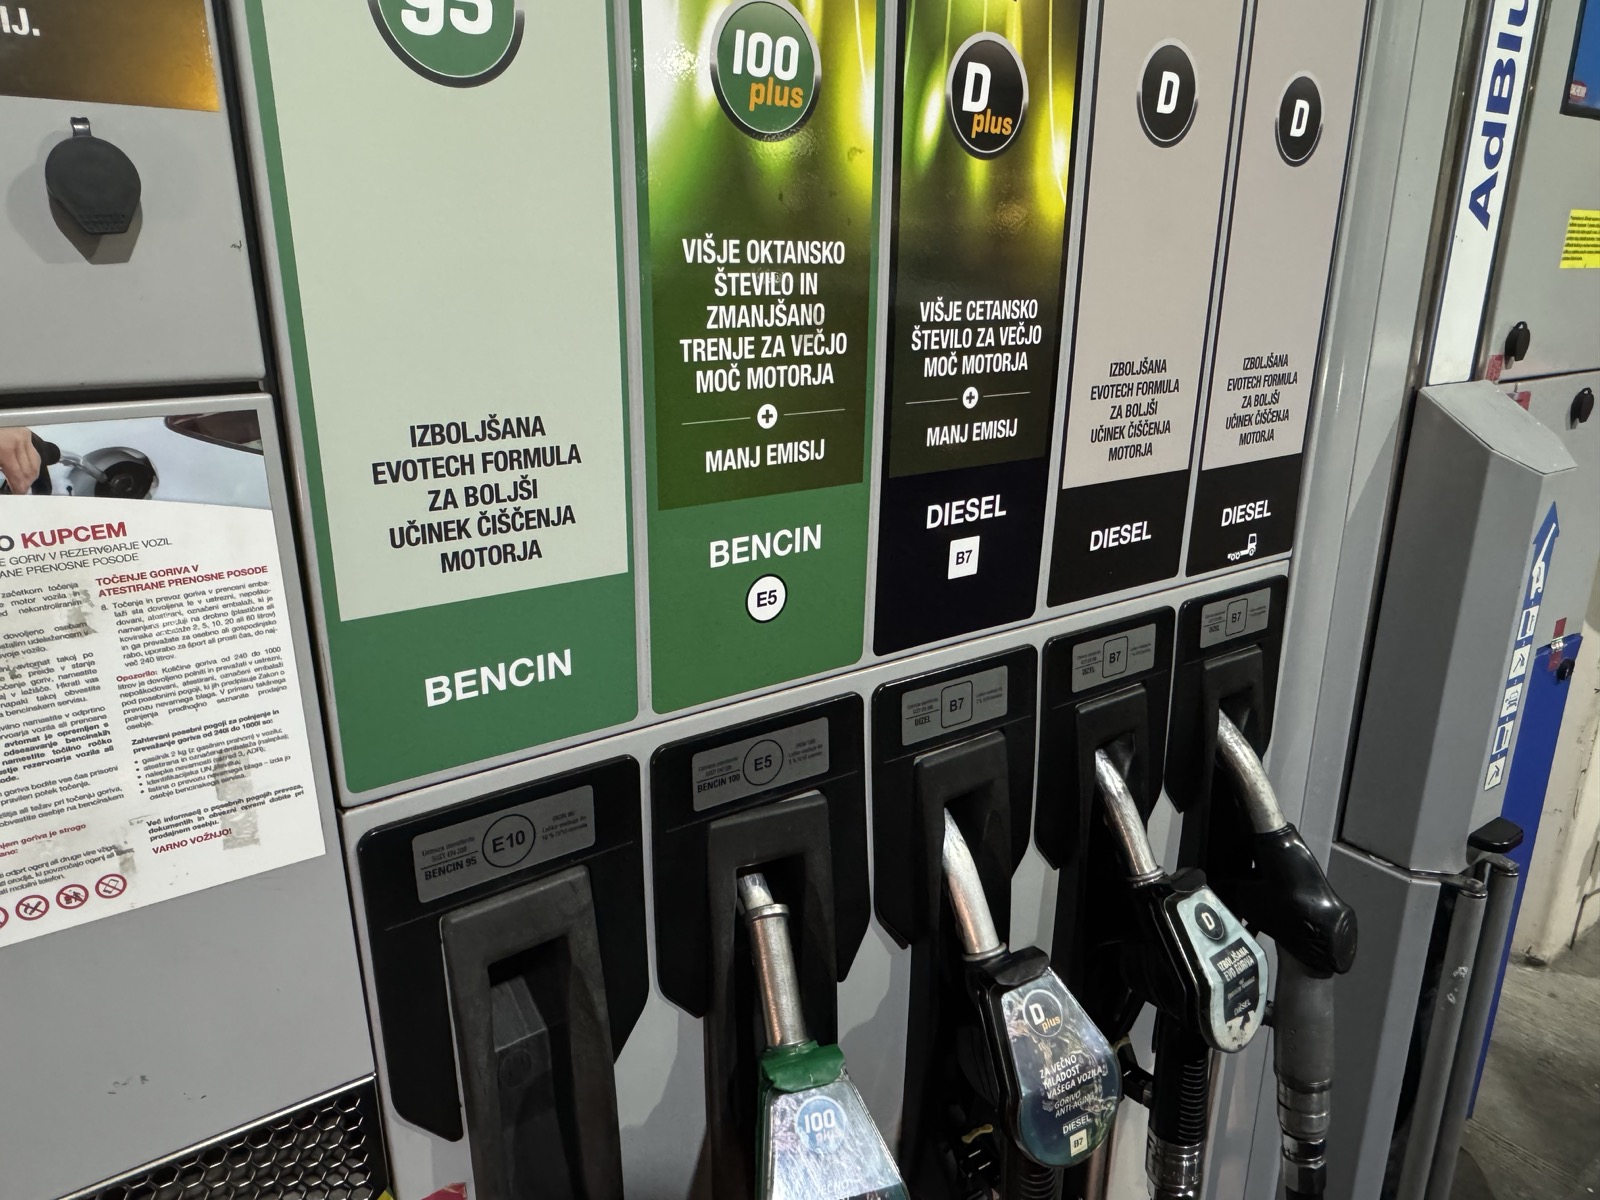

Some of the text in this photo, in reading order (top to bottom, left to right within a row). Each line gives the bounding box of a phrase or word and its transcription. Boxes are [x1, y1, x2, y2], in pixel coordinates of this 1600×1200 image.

[401, 0, 492, 35] 95
[733, 29, 800, 77] 100
[749, 77, 804, 112] plus
[962, 61, 991, 113] D
[1156, 70, 1180, 115] D
[971, 108, 1013, 138] plus
[1289, 98, 1310, 137] D
[682, 233, 846, 265] VIŠJE OKTANSKO
[714, 267, 818, 297] ŠTEVILO IN
[706, 299, 825, 329] ZMANJŠANO
[920, 296, 1038, 322] VIŠJE CETANSKO
[680, 328, 848, 362] TRENJE ZA VEČJO
[911, 321, 1042, 351] ŠTEVILO ZA VEČJO
[924, 351, 1028, 378] MOČ MOTORJA
[1109, 357, 1167, 377] IZBOLJŠANA
[1242, 352, 1289, 371] IZBOLJŠANA
[696, 362, 834, 393] MOČ MOTORJA
[1090, 378, 1180, 401] EVOTECH FORMULA
[1227, 371, 1298, 392] EVOTECH FORMULA
[1109, 398, 1158, 420] ZA BOLJŠI
[1241, 389, 1280, 408] ZA BOLJŠI
[409, 413, 547, 448] IZBOLJŠANA
[1090, 420, 1171, 443] UČINEK ČIŠČENJA
[1225, 408, 1290, 430] UČINEK ČIŠČENJA
[926, 418, 1018, 447] MANJ EMISIJ
[1238, 428, 1275, 447] MOTORJA
[371, 443, 582, 485] EVOTECH FORMULA
[705, 438, 825, 473] MANJ EMISIJ
[1108, 442, 1153, 462] MOTORJA
[427, 474, 538, 512] ZA BOLJŠI
[926, 494, 1007, 530] DIESEL
[1221, 499, 1272, 527] DIESEL
[21, 521, 128, 549] KUPCEM
[389, 504, 576, 549] UČINEK ČIŠČENJA
[1090, 521, 1152, 551] DIESEL
[9, 537, 173, 566] GORIV V REZERVOARJE VOZIL
[440, 539, 542, 574] MOTORJA
[709, 524, 822, 569] BENCIN
[955, 549, 973, 566] B7
[26, 559, 90, 576] PRENOSNE
[92, 552, 140, 567] POSODE
[95, 564, 199, 587] TOČENJE GORIVA V
[98, 565, 268, 598] ATESTIRANE PRENOSNE POSODE
[756, 589, 777, 608] E5
[1231, 611, 1242, 623] B7
[116, 670, 157, 682] Opozorilo:
[161, 664, 192, 674] Količine
[195, 659, 217, 669] goriva
[264, 646, 281, 654] 1000
[1109, 650, 1122, 664] B7
[424, 648, 573, 708] BENCIN
[949, 697, 965, 712] B7
[4, 724, 100, 748] avtomat je opremljen
[132, 732, 170, 745] Zahtevani
[171, 725, 202, 738] posebni
[204, 720, 227, 730] pogoji
[239, 711, 271, 723] polnjenje
[1, 738, 113, 766] namestite točilno ročko
[3, 729, 111, 757] odsesavanje bencinskih
[133, 740, 176, 754] prevažanje
[177, 734, 201, 745] goriva
[23, 745, 114, 770] rezervoarja vozila ali
[754, 754, 772, 772] E5
[697, 774, 741, 793] BENCIN 100
[148, 794, 292, 834] dokumentih obvezni opremi dobite
[163, 808, 202, 823] informacij
[211, 798, 244, 812] posebnih
[246, 791, 272, 804] pogojih
[274, 784, 303, 796] prevoza,
[20, 824, 87, 845] goriva je strogo
[150, 820, 219, 842] prodajnem osebju.
[152, 828, 232, 854] VARNO VOŽNJO!
[492, 830, 526, 853] E10
[424, 856, 478, 881] BENCIN 95
[1201, 912, 1216, 931] D
[1029, 1002, 1046, 1026] D
[1041, 1014, 1061, 1032] plus
[1039, 1054, 1077, 1079] ZA VEČNO
[1042, 1064, 1080, 1090] MLADOST
[1047, 1065, 1103, 1099] VAŠEGA VOZILA
[1054, 1090, 1081, 1109] GORIVO
[804, 1109, 836, 1134] 100
[1063, 1115, 1091, 1134] DIESEL
[1073, 1137, 1083, 1148] B7
